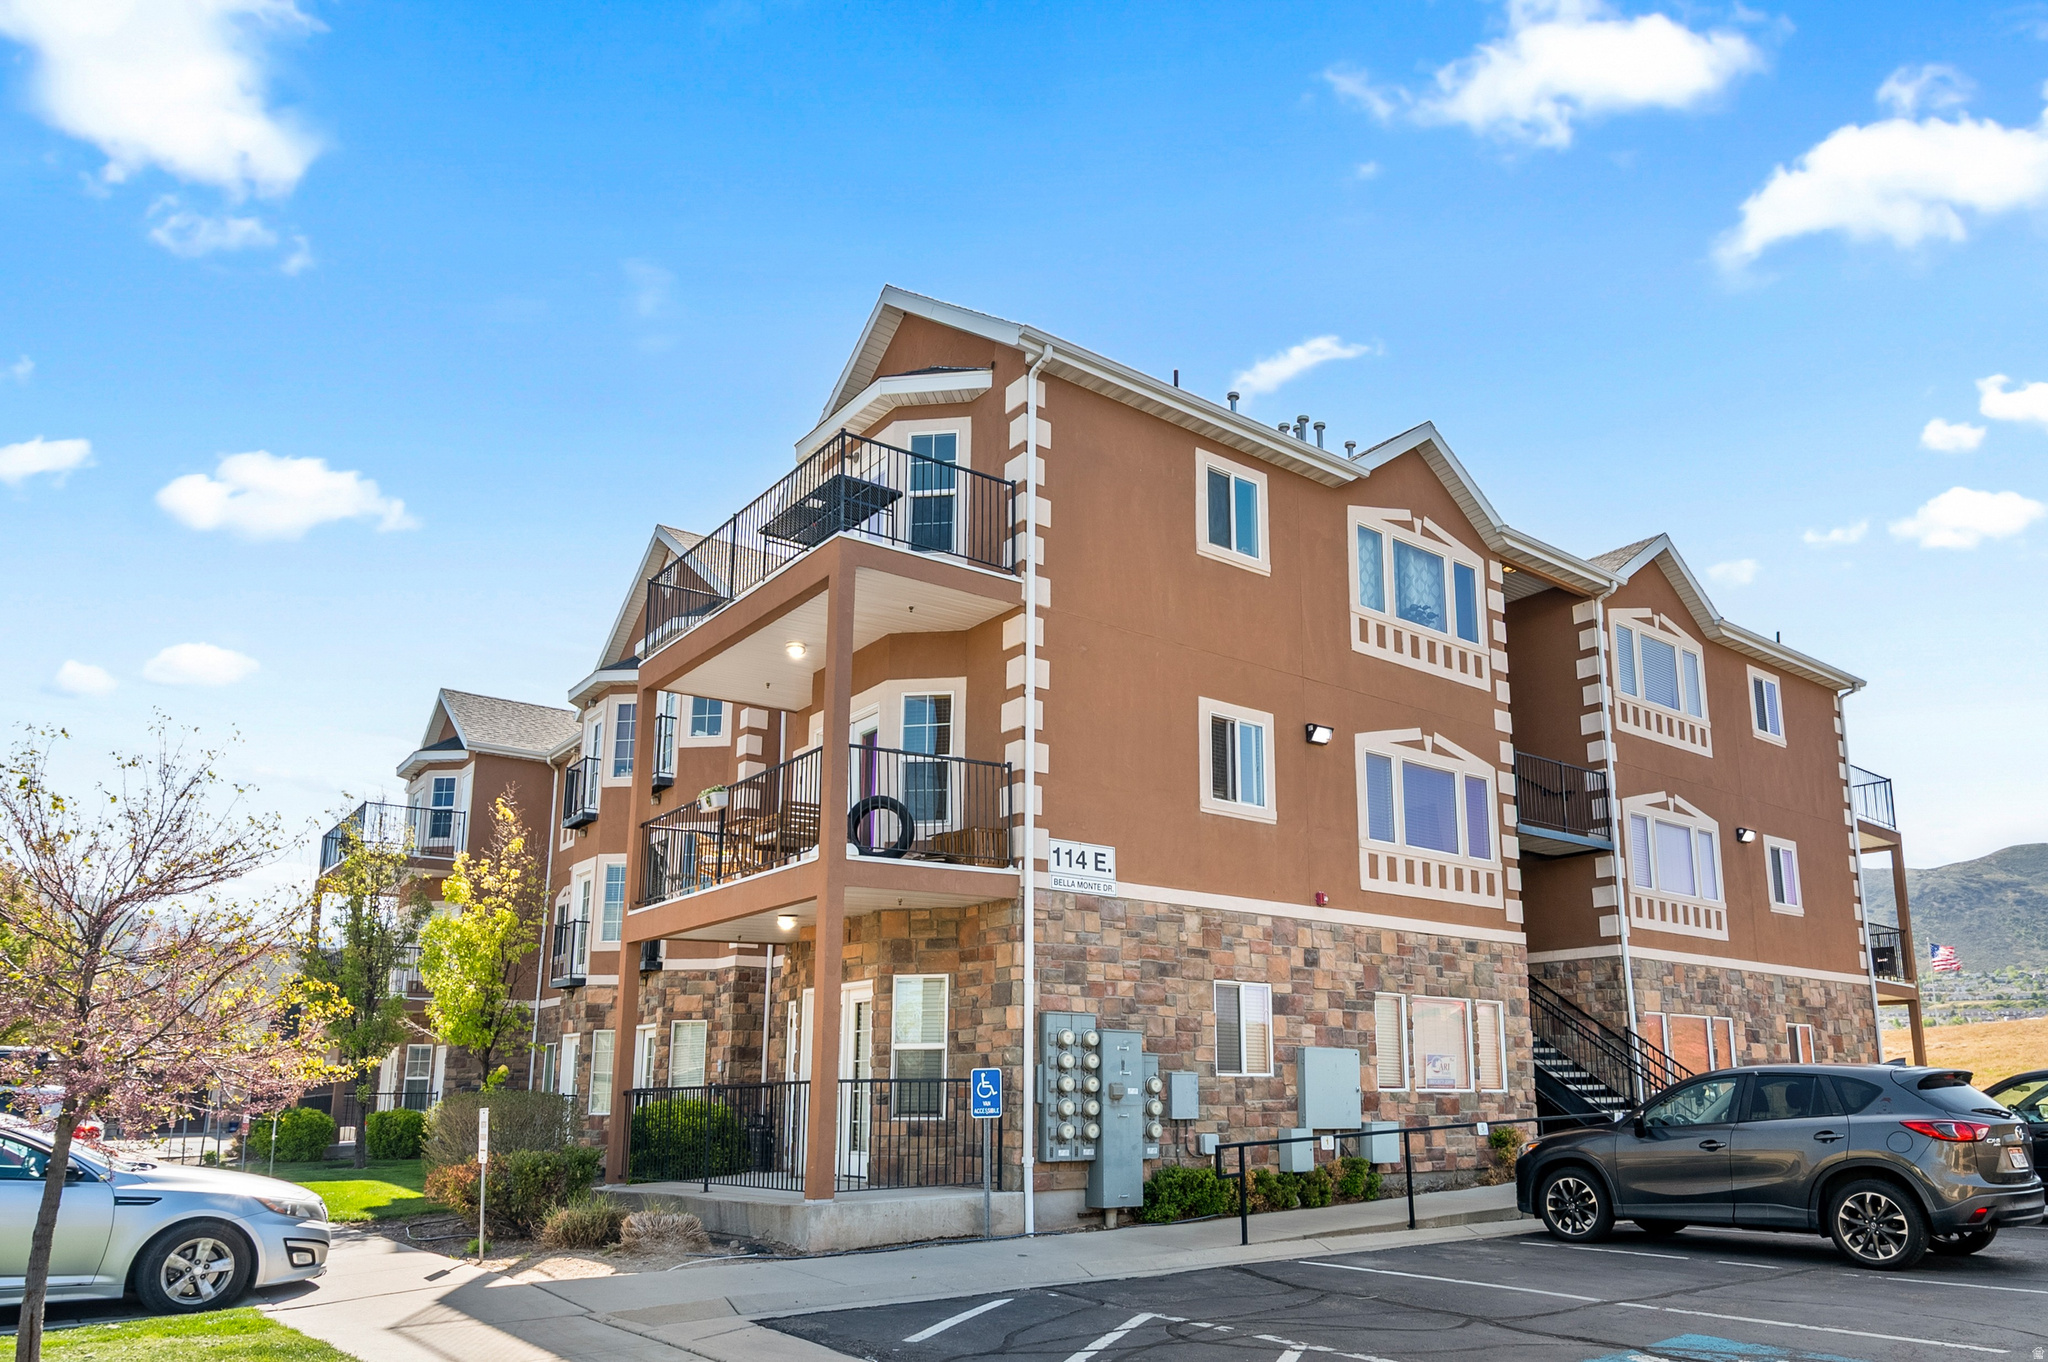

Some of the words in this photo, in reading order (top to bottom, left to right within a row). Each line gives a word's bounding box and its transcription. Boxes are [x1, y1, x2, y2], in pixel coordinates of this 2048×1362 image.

[1052, 847, 1087, 870] 114
[1094, 852, 1112, 873] E.
[1053, 878, 1076, 888] BELLA
[1077, 881, 1102, 891] MONTE
[1103, 884, 1114, 892] DR.
